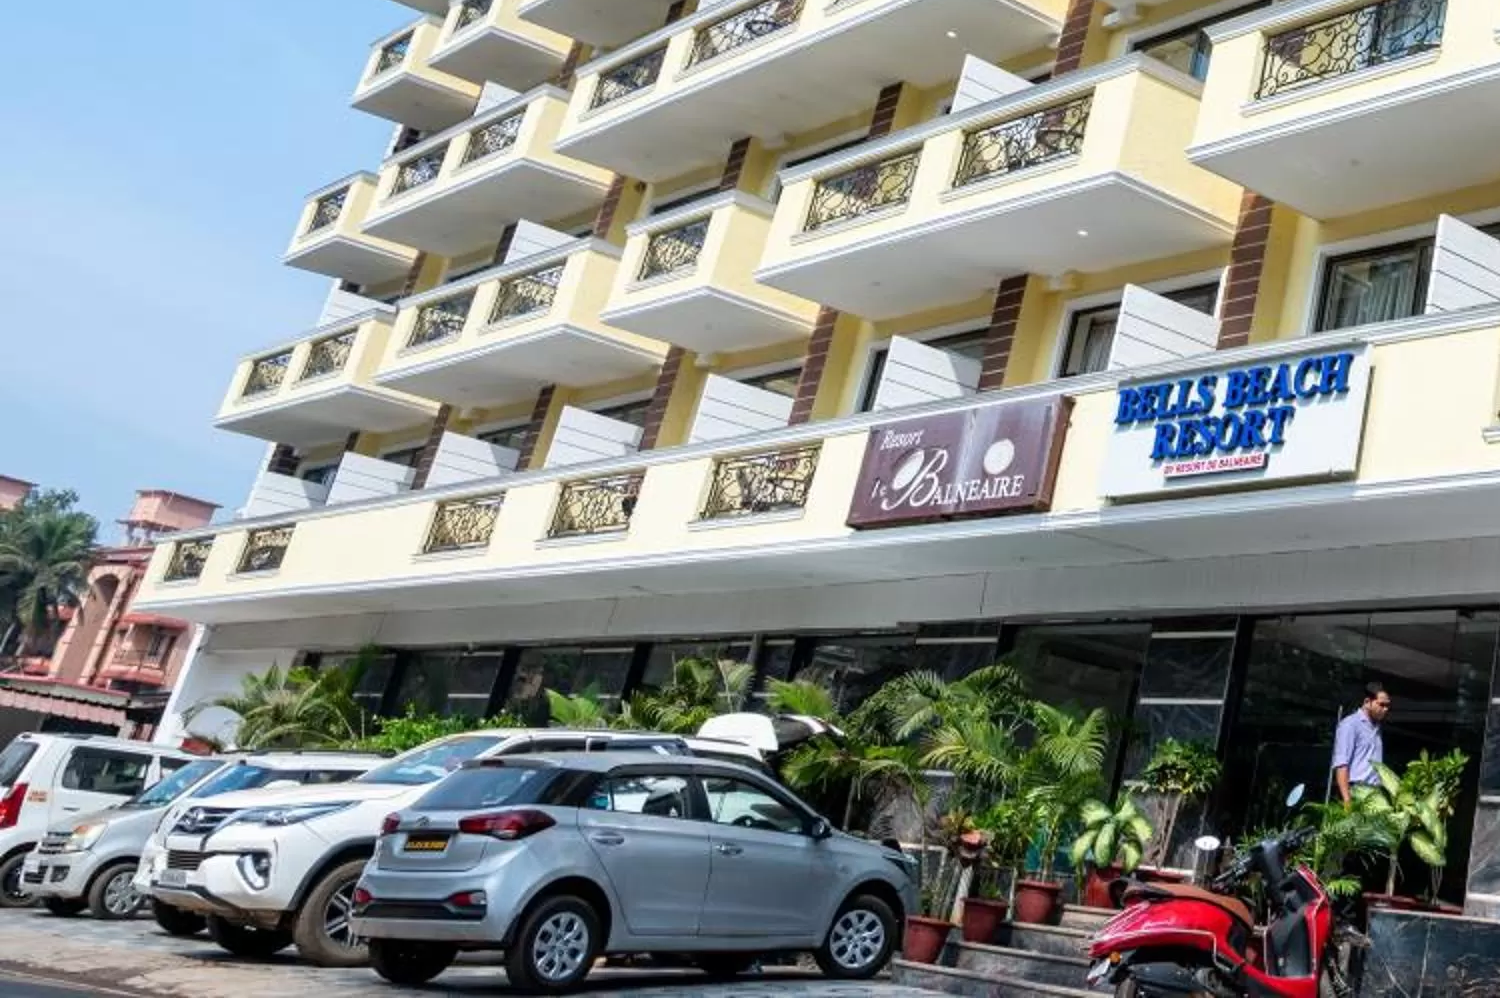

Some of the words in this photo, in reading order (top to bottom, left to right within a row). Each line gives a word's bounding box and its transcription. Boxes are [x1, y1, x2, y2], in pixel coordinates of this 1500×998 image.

[1115, 376, 1218, 424] BELLS
[1222, 353, 1354, 408] BEACH
[881, 430, 923, 450] Resort
[1150, 405, 1295, 459] RESORT
[1175, 461, 1206, 473] RESORT
